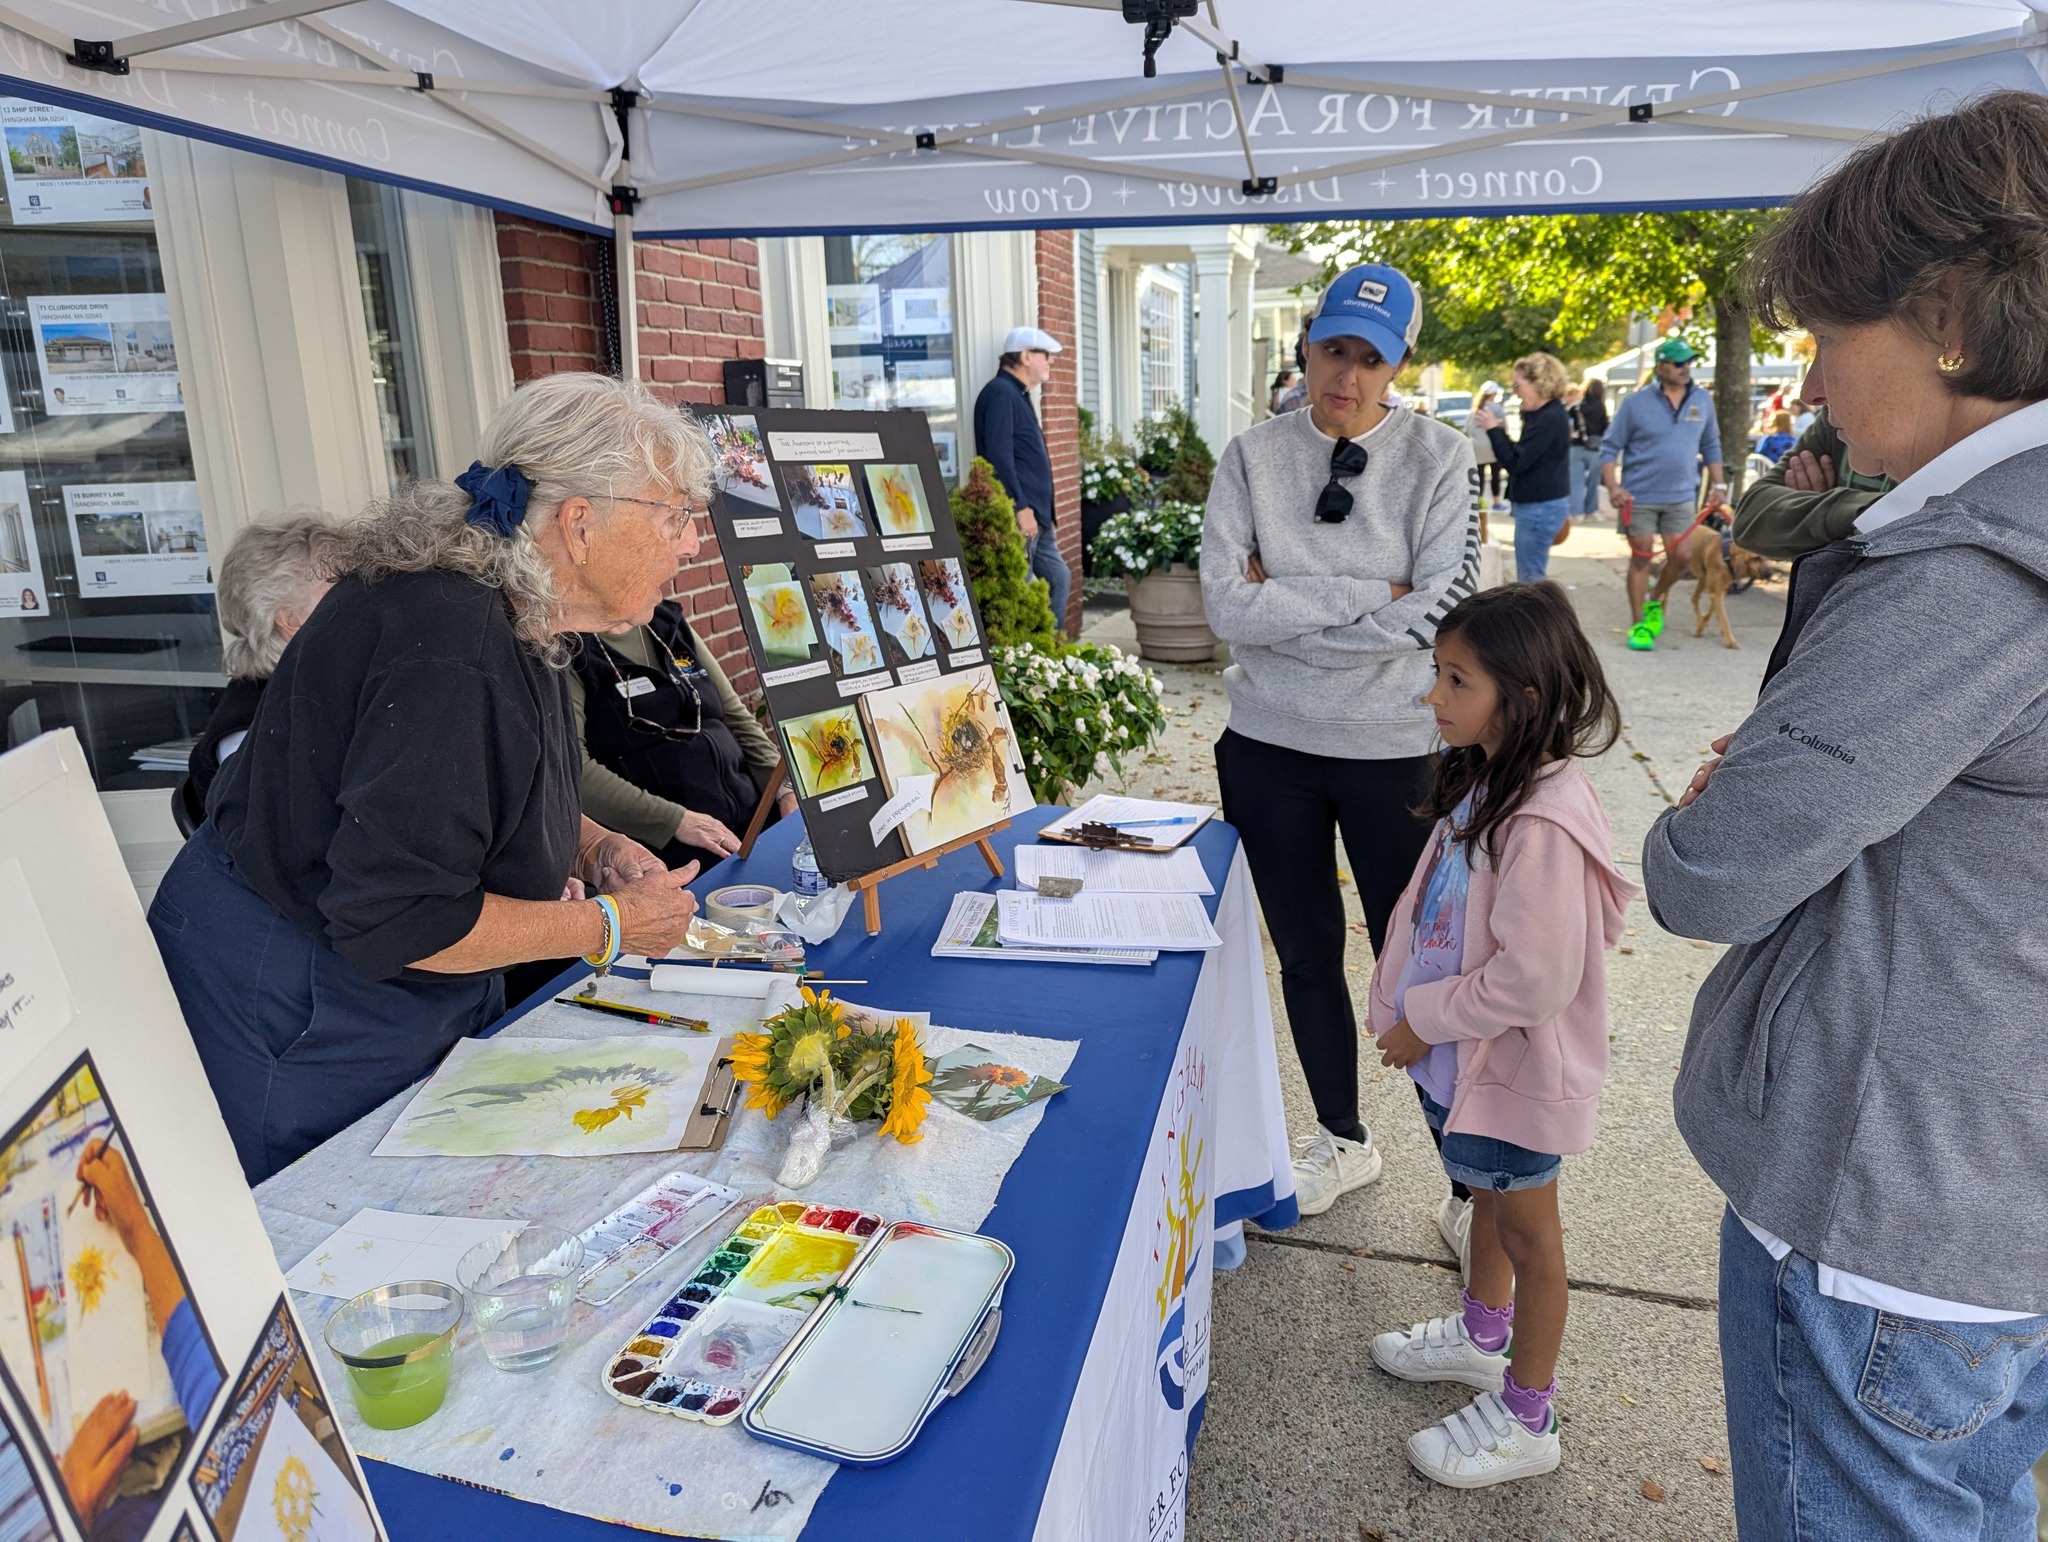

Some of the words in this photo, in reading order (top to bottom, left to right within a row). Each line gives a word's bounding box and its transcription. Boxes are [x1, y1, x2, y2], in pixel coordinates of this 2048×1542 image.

[1788, 727, 1856, 765] Columbia
[1432, 919, 1453, 941] my
[1418, 935, 1458, 951] ement
